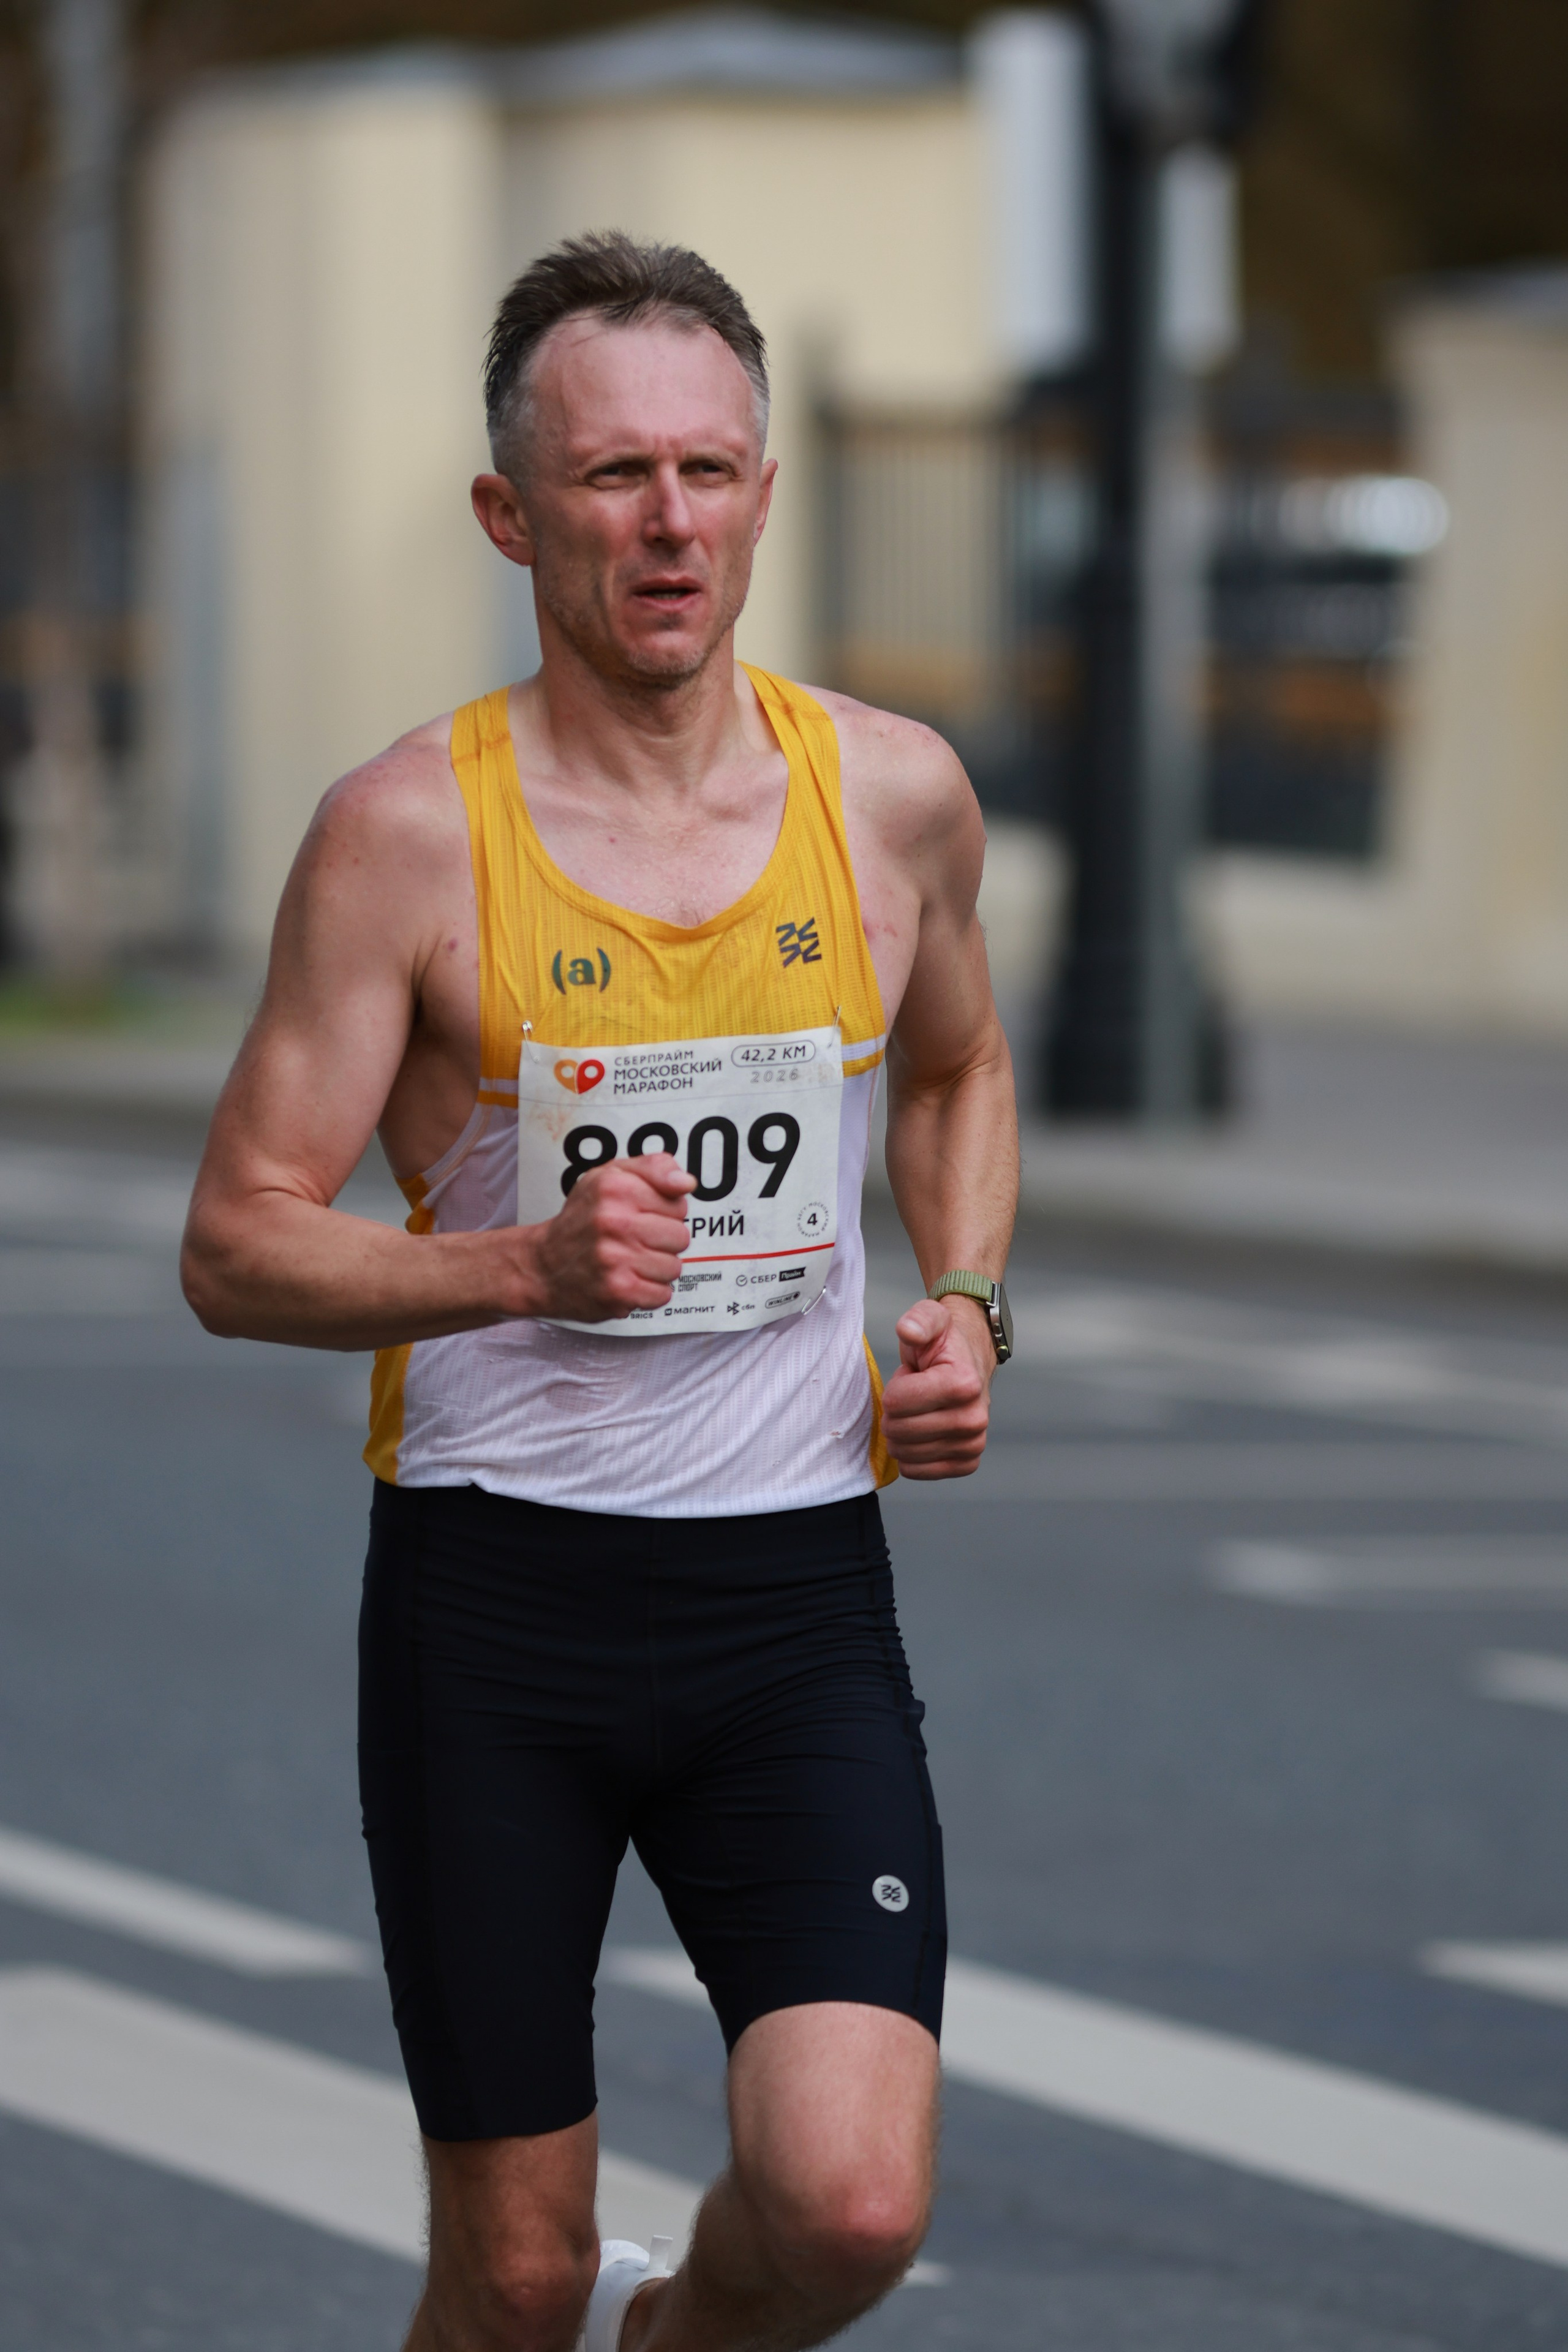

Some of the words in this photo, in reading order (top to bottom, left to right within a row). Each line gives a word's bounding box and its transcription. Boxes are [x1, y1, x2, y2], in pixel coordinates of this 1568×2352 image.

[614, 1050, 693, 1066] СБЕРПРАЙМ
[741, 1048, 775, 1063] 42,2
[614, 1058, 722, 1080] МОСКОВСКИЙ
[750, 1069, 799, 1084] 2026
[614, 1077, 693, 1095] МАРАФОН
[807, 1213, 818, 1226] 4
[678, 1271, 722, 1283] МОСКОВСКИЙ
[750, 1274, 777, 1284] СБЕР
[678, 1283, 698, 1292] СПОРТ
